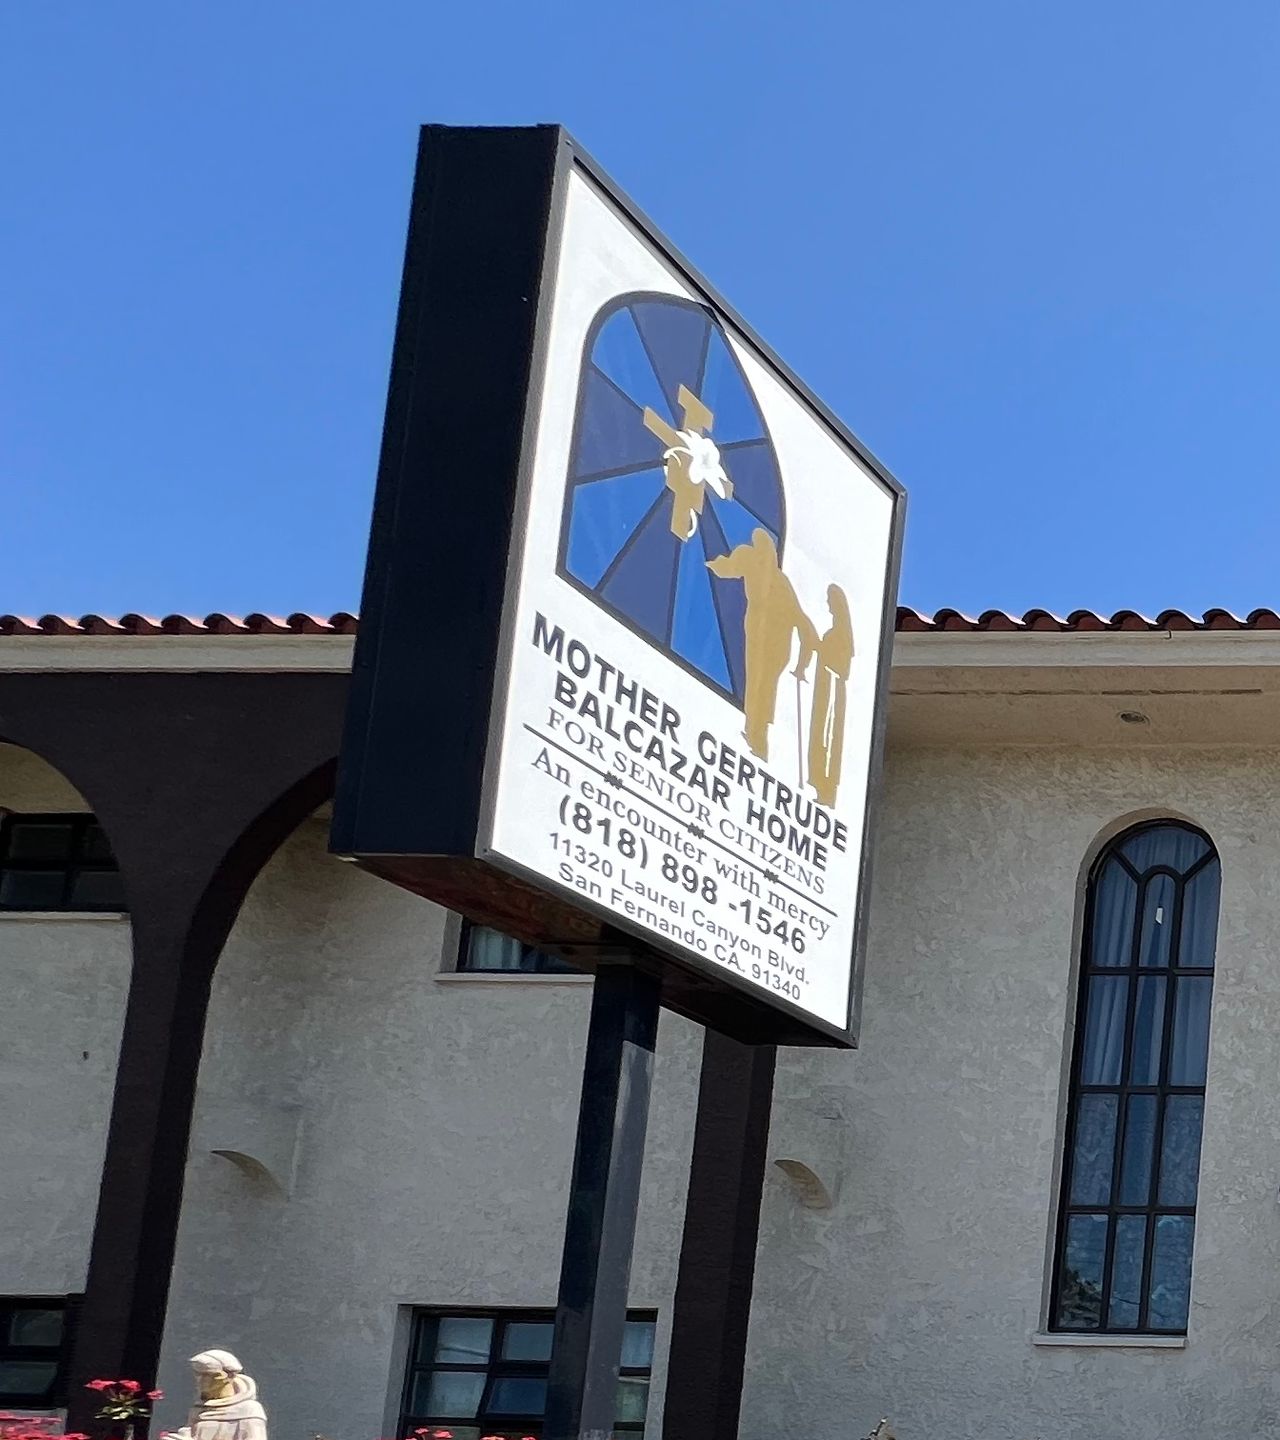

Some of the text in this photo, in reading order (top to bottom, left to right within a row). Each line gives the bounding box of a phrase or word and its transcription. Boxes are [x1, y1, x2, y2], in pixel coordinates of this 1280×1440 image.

[532, 610, 848, 852] MOTHER GERTRUDE
[546, 706, 825, 894] FOR SENIOR CITIZENS
[555, 670, 828, 871] BALCAZAR HOME
[531, 747, 831, 940] An encounter with mercy
[549, 832, 810, 985] 11320 Laurel Canyon Blvd.
[558, 862, 601, 898] San
[610, 888, 707, 951] Fernando
[752, 963, 801, 1001] 91340
[559, 794, 648, 869] (818)
[661, 853, 718, 905] 898
